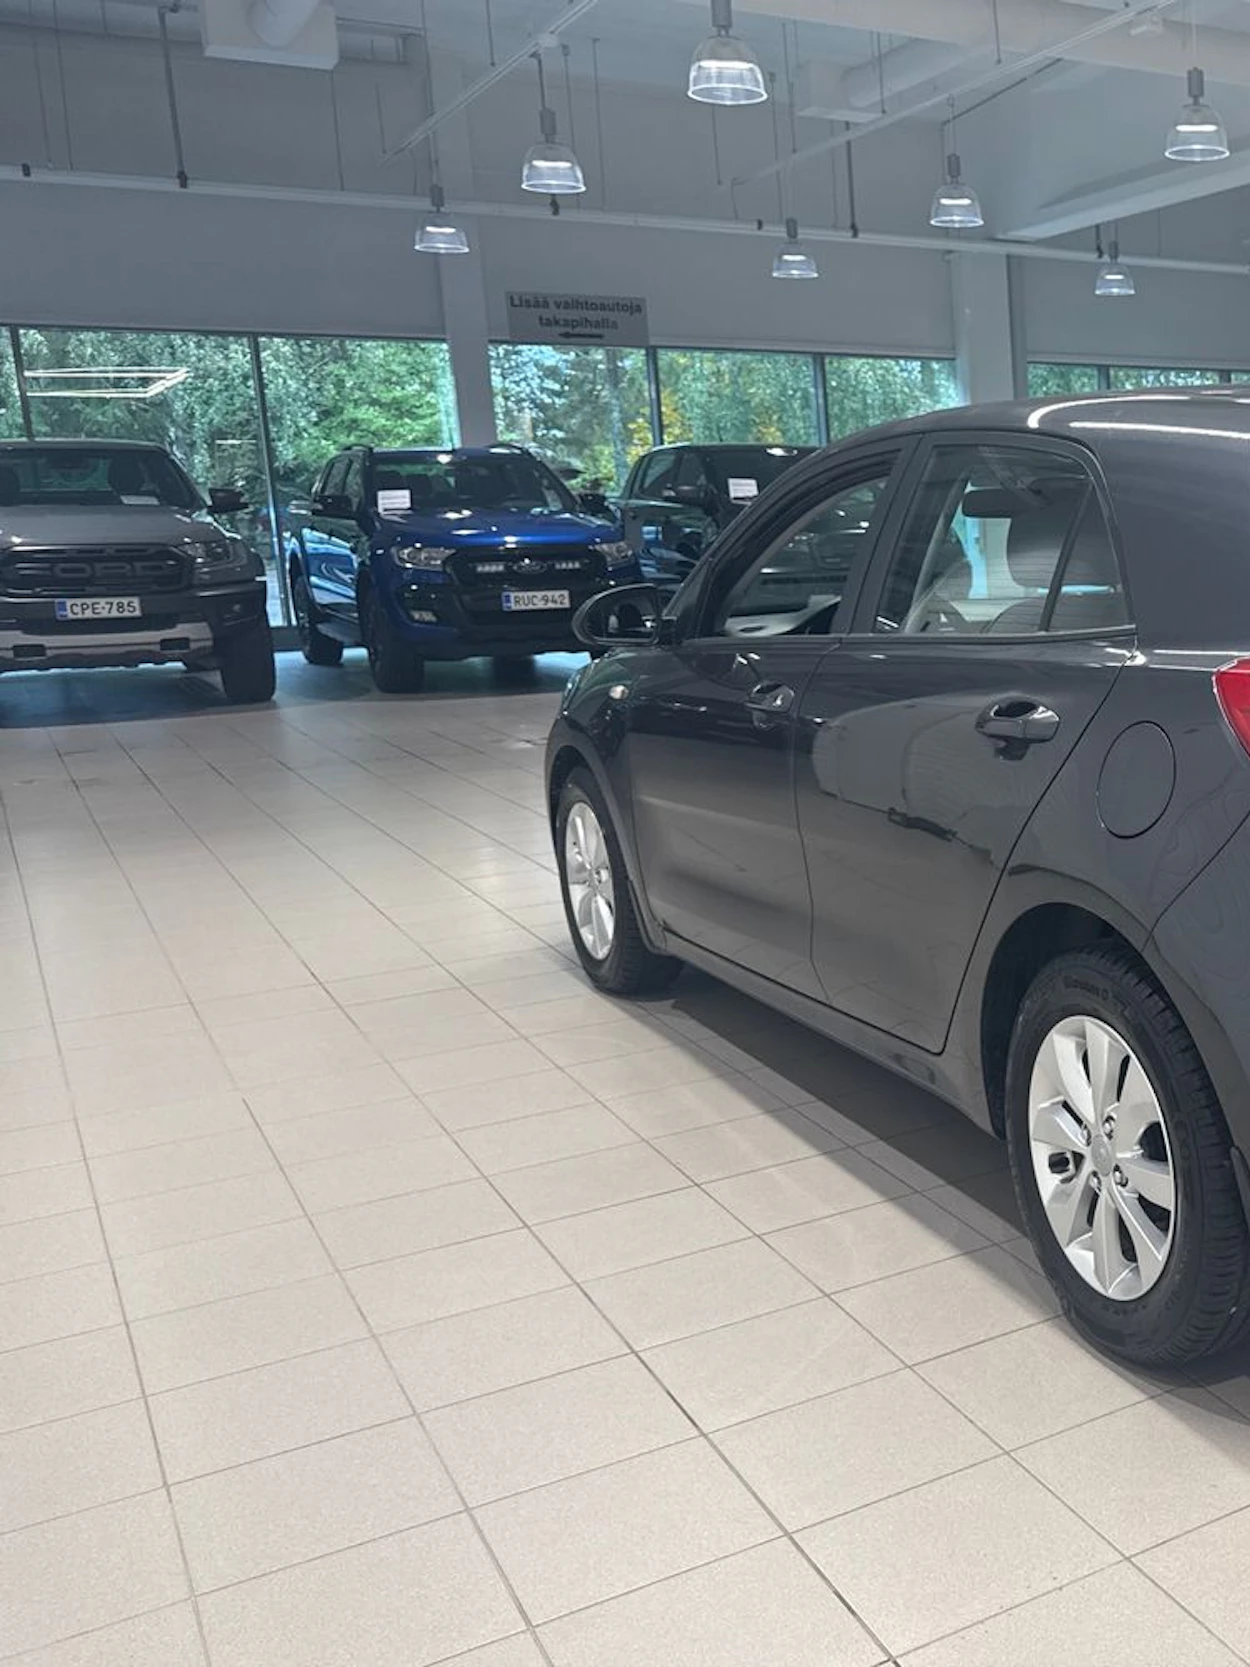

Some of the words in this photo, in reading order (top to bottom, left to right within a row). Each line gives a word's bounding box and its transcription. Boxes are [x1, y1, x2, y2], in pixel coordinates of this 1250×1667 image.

[509, 295, 550, 309] Lisää
[553, 298, 643, 315] vaihtoautoja
[538, 315, 619, 330] takapihalla
